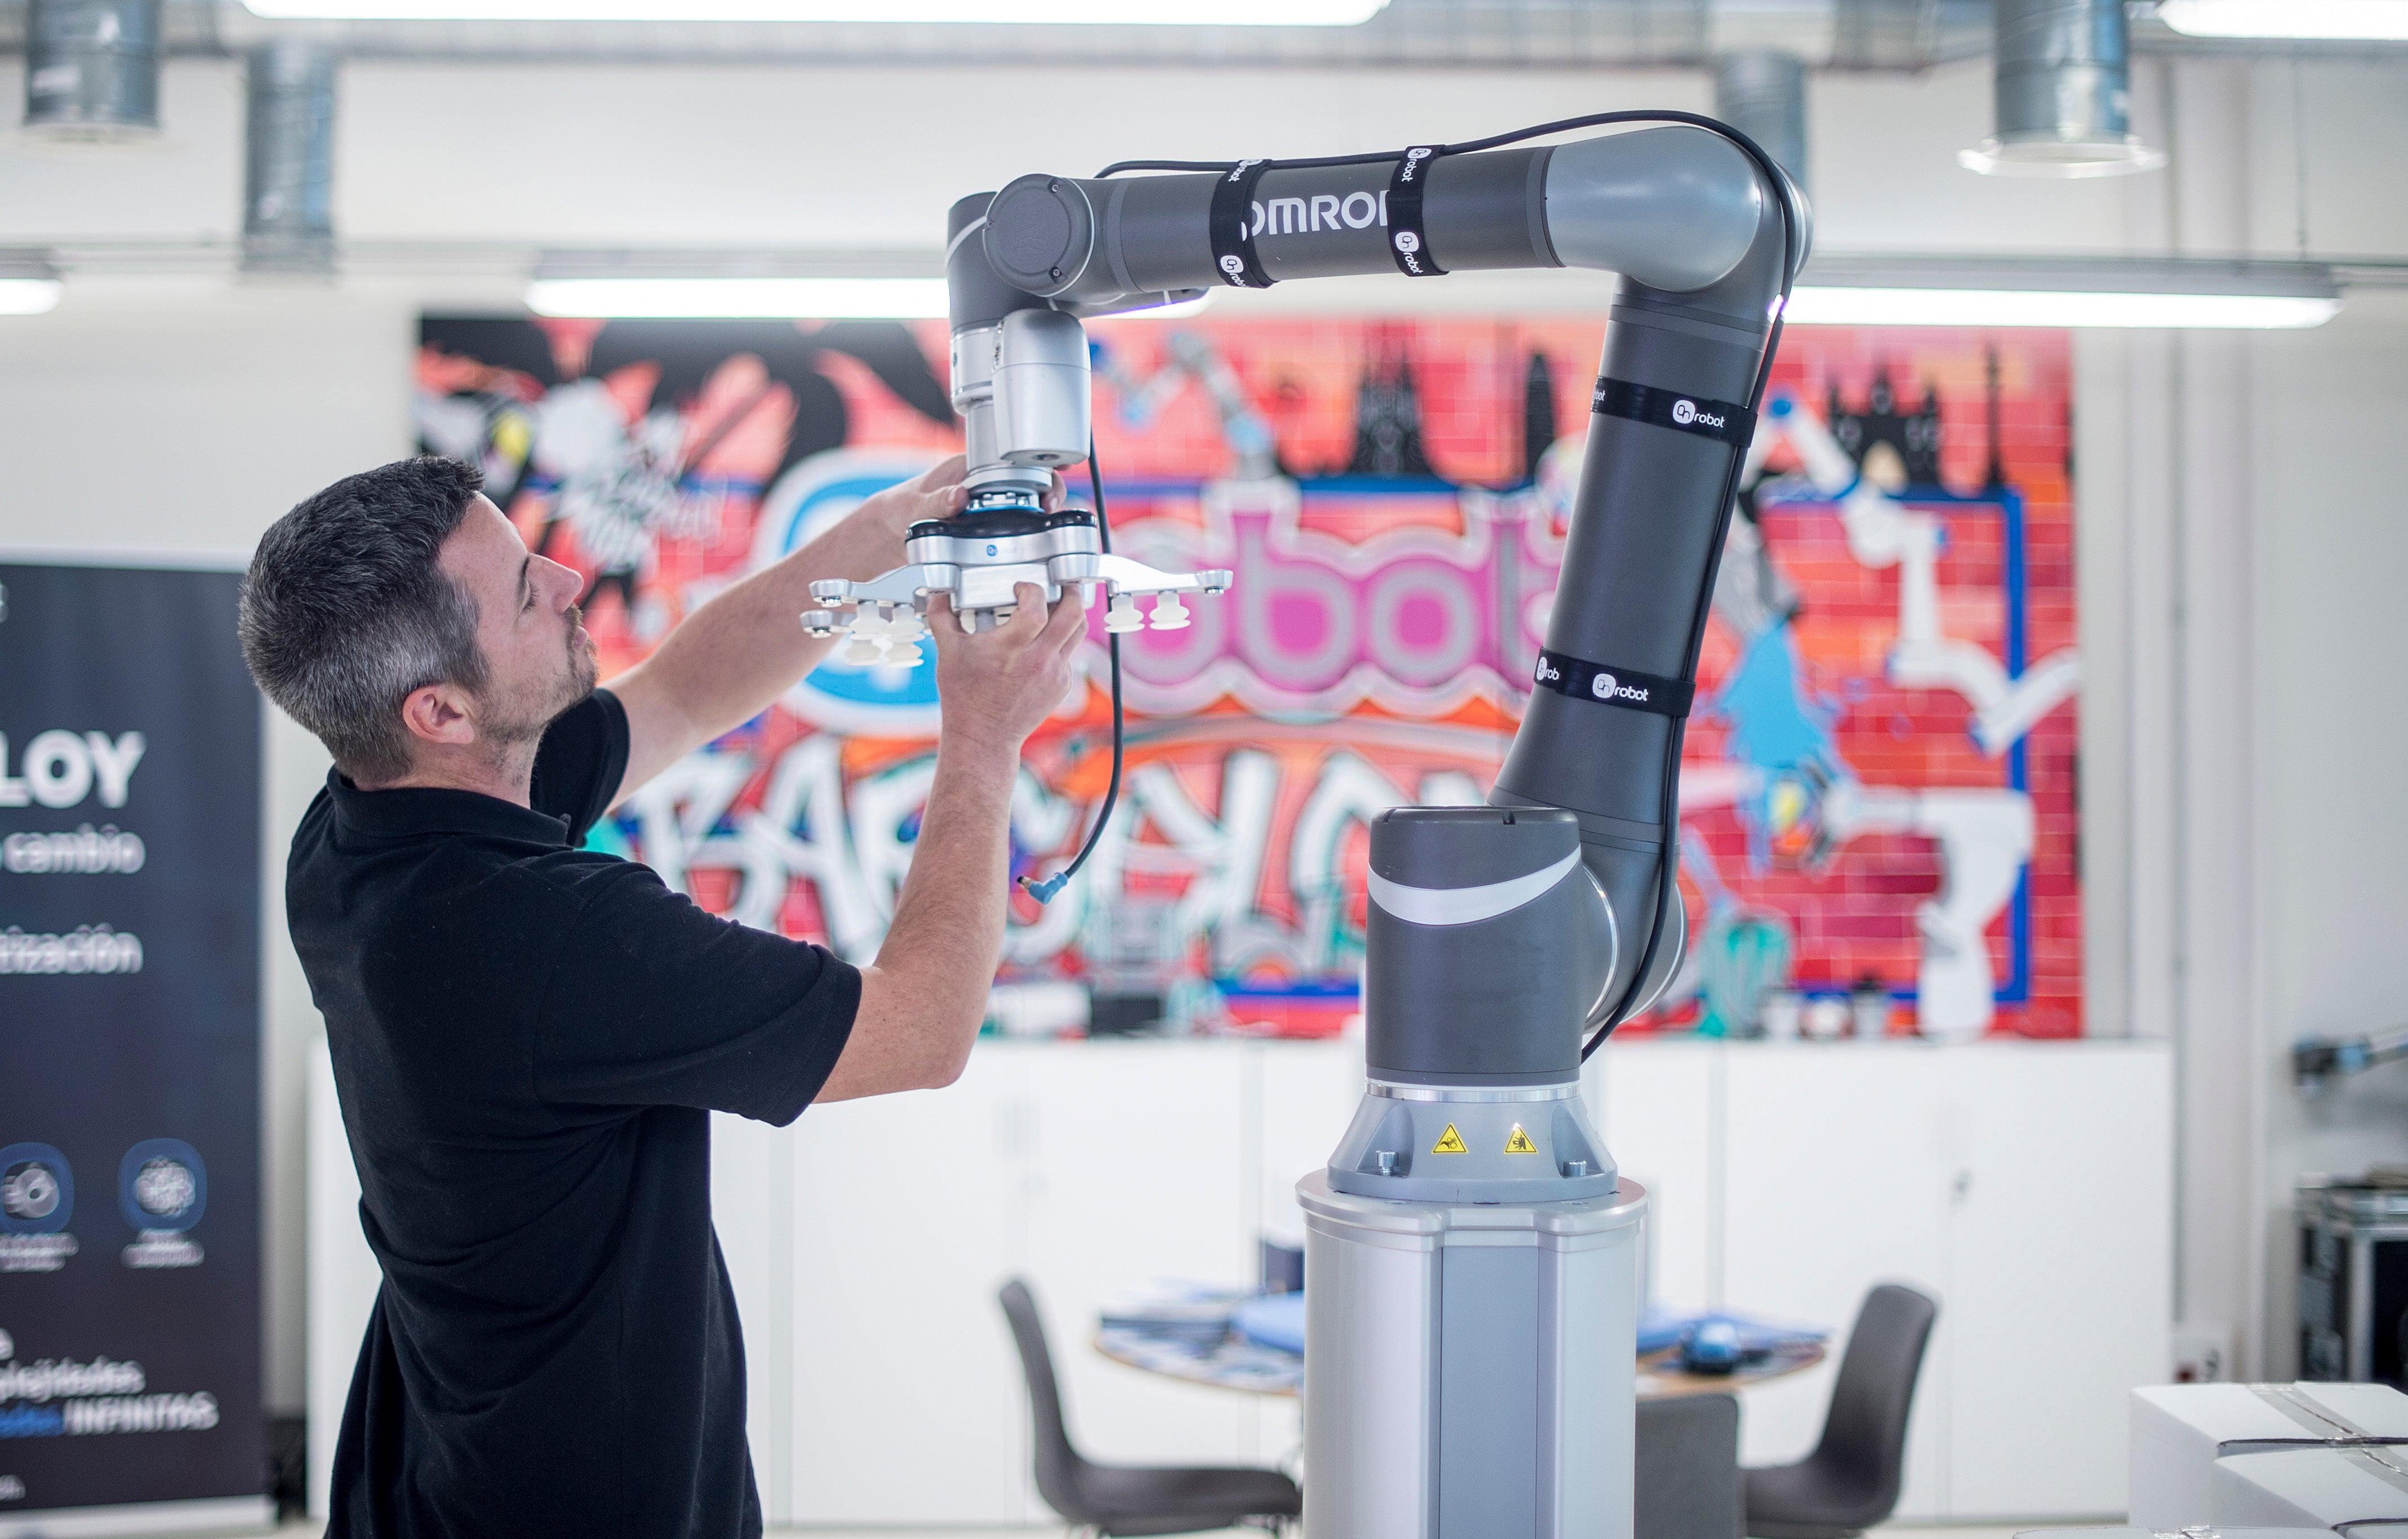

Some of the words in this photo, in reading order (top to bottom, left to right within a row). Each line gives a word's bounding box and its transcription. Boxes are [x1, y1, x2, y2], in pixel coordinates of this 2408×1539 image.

[1251, 191, 1390, 237] MRO
[0, 728, 148, 809] LOY
[2, 822, 147, 874] cambio
